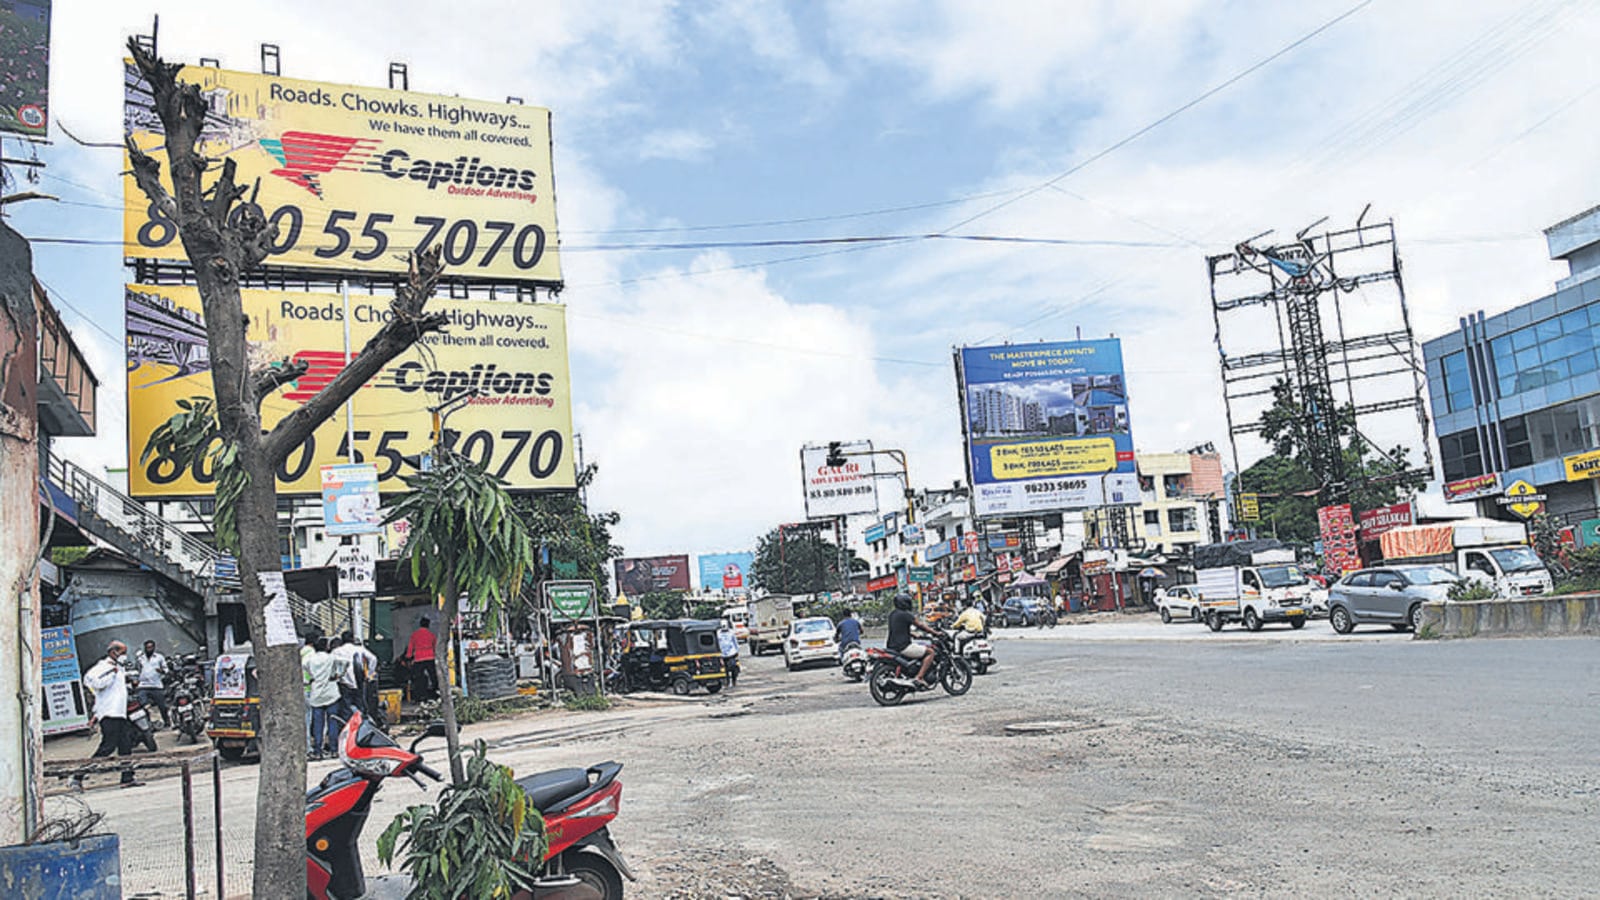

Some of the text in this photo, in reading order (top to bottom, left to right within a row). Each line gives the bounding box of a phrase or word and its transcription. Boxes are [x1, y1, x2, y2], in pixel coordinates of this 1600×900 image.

[270, 83, 531, 129] Roads. Chowks. Highways...
[369, 119, 532, 148] We have them all covered.
[375, 149, 537, 190] Captions
[447, 183, 537, 204] Outdoor Advertising
[314, 209, 394, 261] 55
[414, 215, 546, 270] 7070
[443, 333, 476, 347] them
[479, 334, 494, 346] all
[496, 336, 550, 349] covered.
[388, 361, 553, 401] Captions
[503, 396, 554, 408] Advertising
[336, 430, 409, 482] 55
